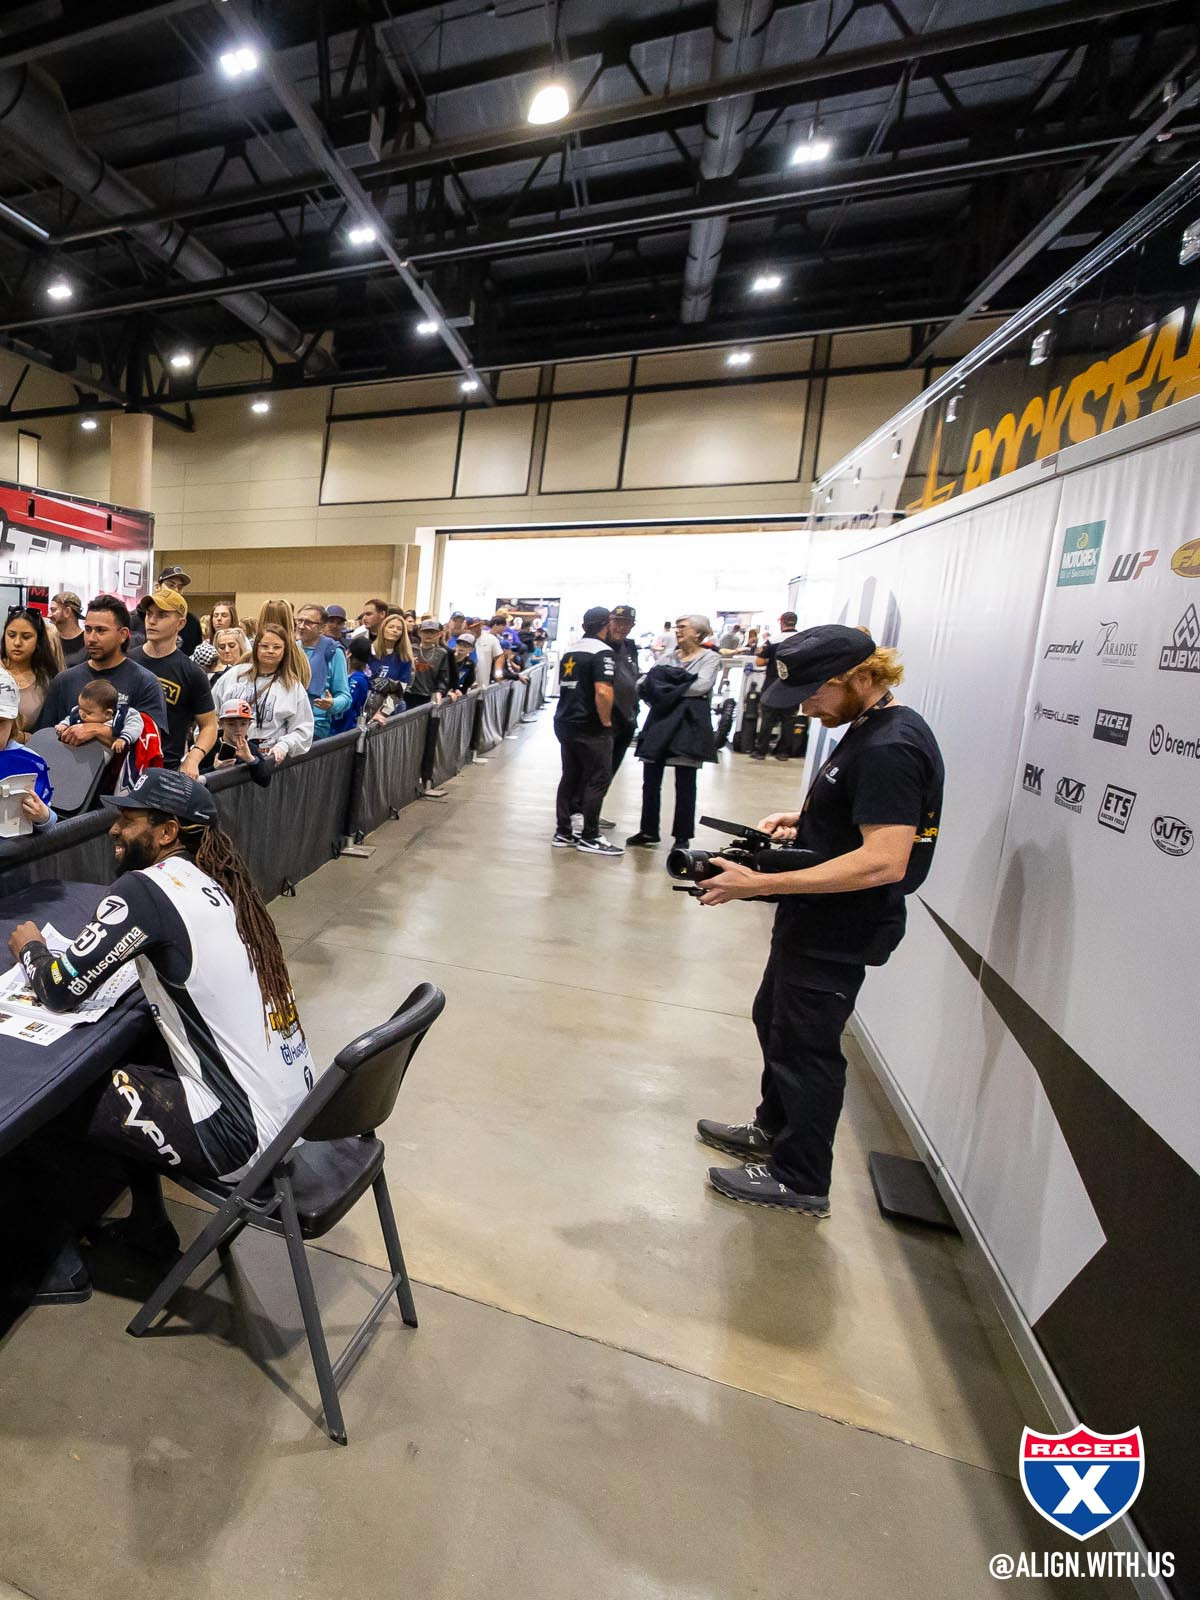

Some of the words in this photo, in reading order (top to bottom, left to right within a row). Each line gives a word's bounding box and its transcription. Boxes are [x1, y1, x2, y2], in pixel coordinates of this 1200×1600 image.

[1061, 547, 1100, 569] MOTOREX
[1107, 549, 1159, 582] WP
[1096, 712, 1129, 731] EXCEL
[1164, 731, 1200, 760] bremb
[1022, 763, 1045, 791] RK
[1103, 791, 1132, 818] ETS
[1154, 816, 1193, 846] GUTS
[83, 926, 142, 983] Husqvarna
